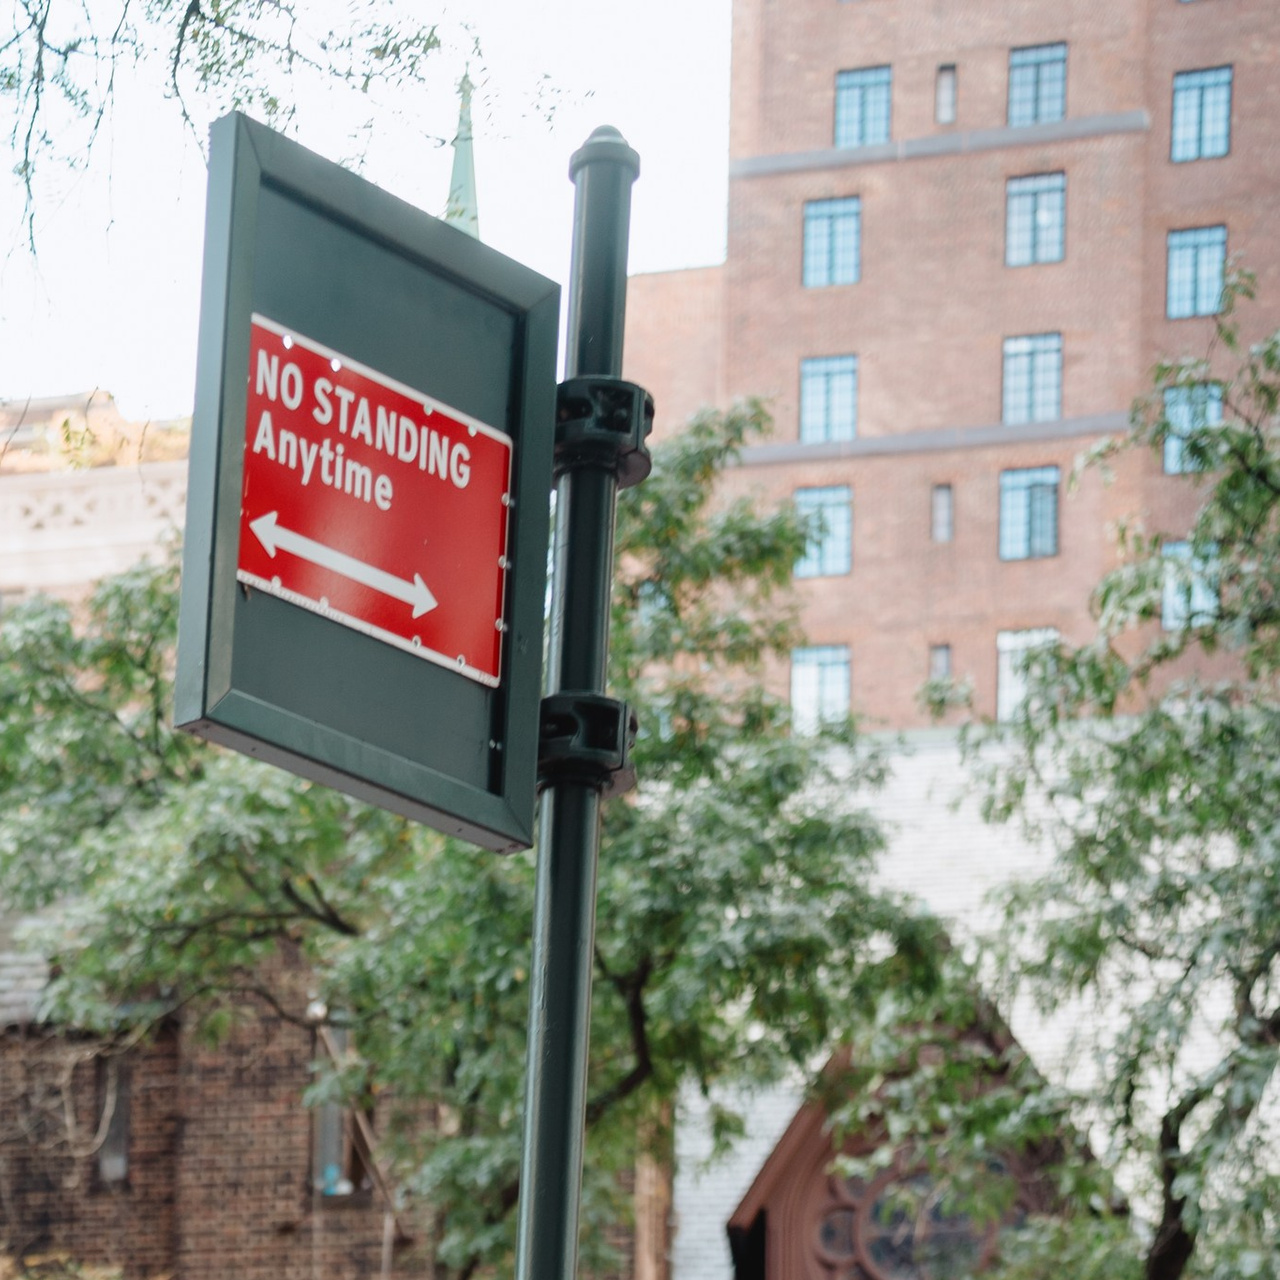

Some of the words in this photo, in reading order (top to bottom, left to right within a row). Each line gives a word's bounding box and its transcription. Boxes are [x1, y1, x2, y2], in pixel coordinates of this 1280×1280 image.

[252, 410, 393, 511] Anytime
[255, 348, 304, 411] NO
[312, 377, 471, 489] STANDING
